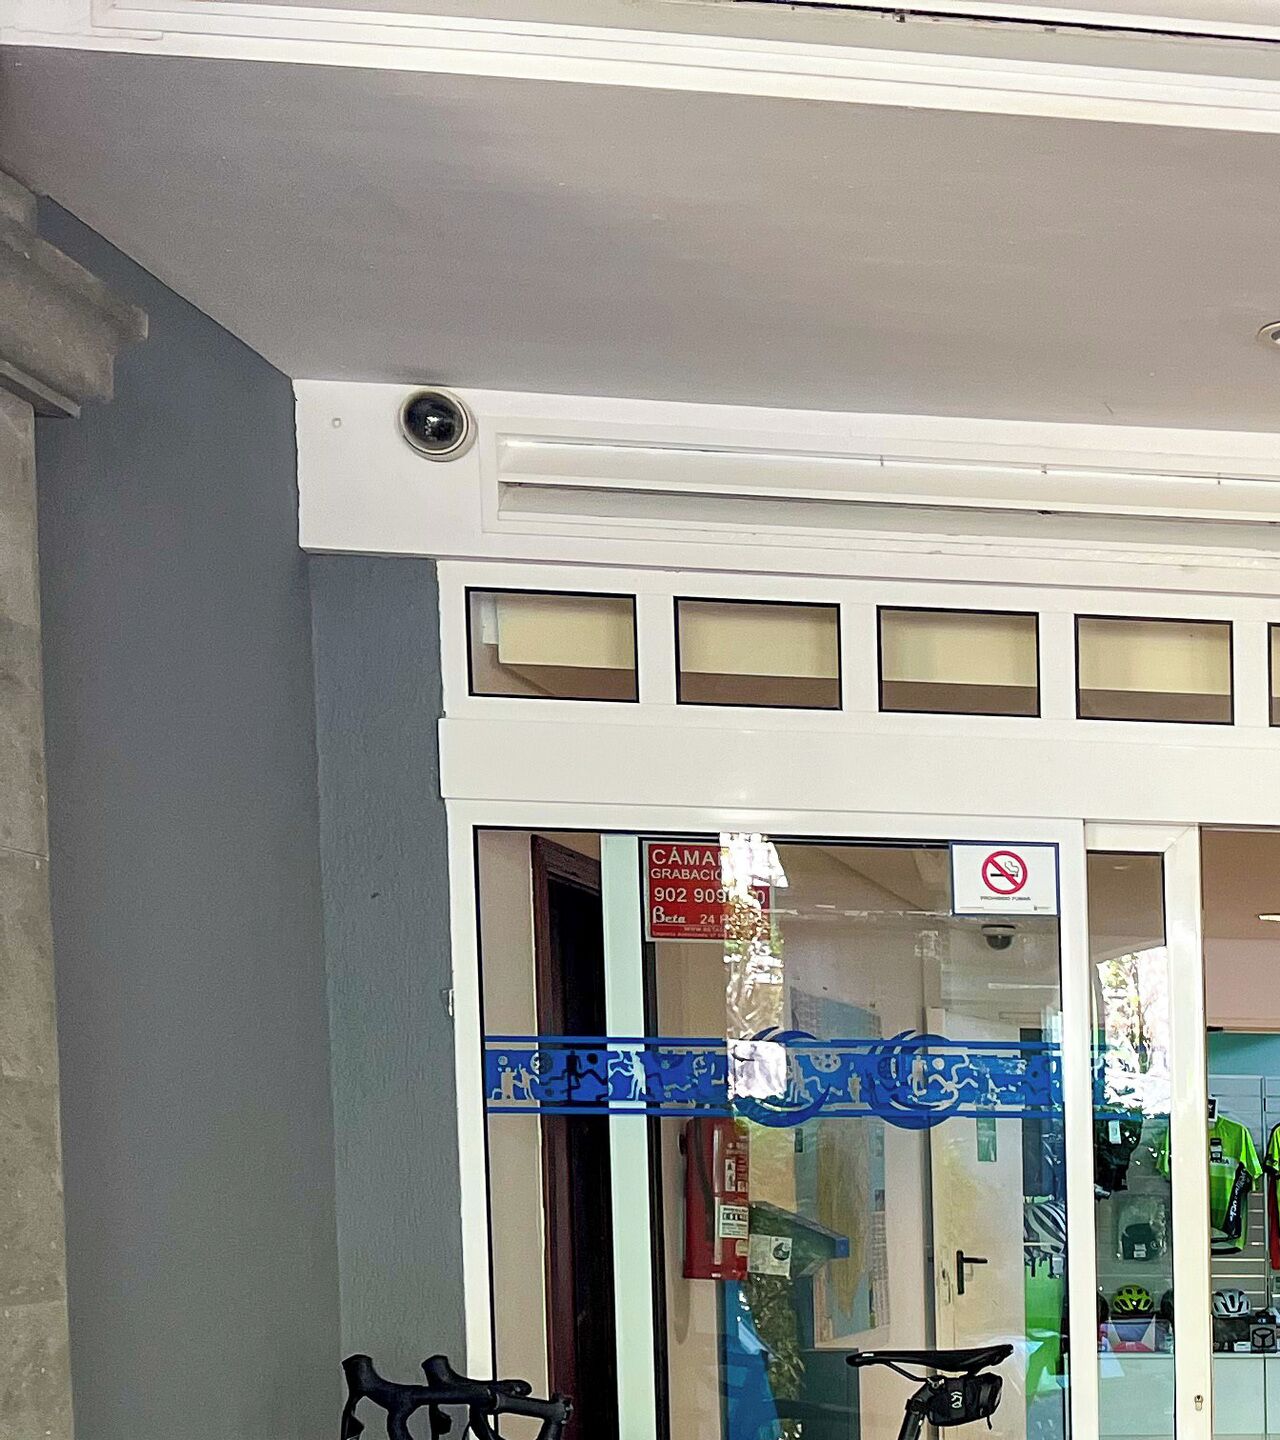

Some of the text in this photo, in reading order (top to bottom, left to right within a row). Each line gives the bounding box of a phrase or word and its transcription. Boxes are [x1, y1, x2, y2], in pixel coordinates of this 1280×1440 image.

[654, 887, 687, 902] 902
[694, 888, 727, 903] 909
[700, 914, 715, 924] 24
